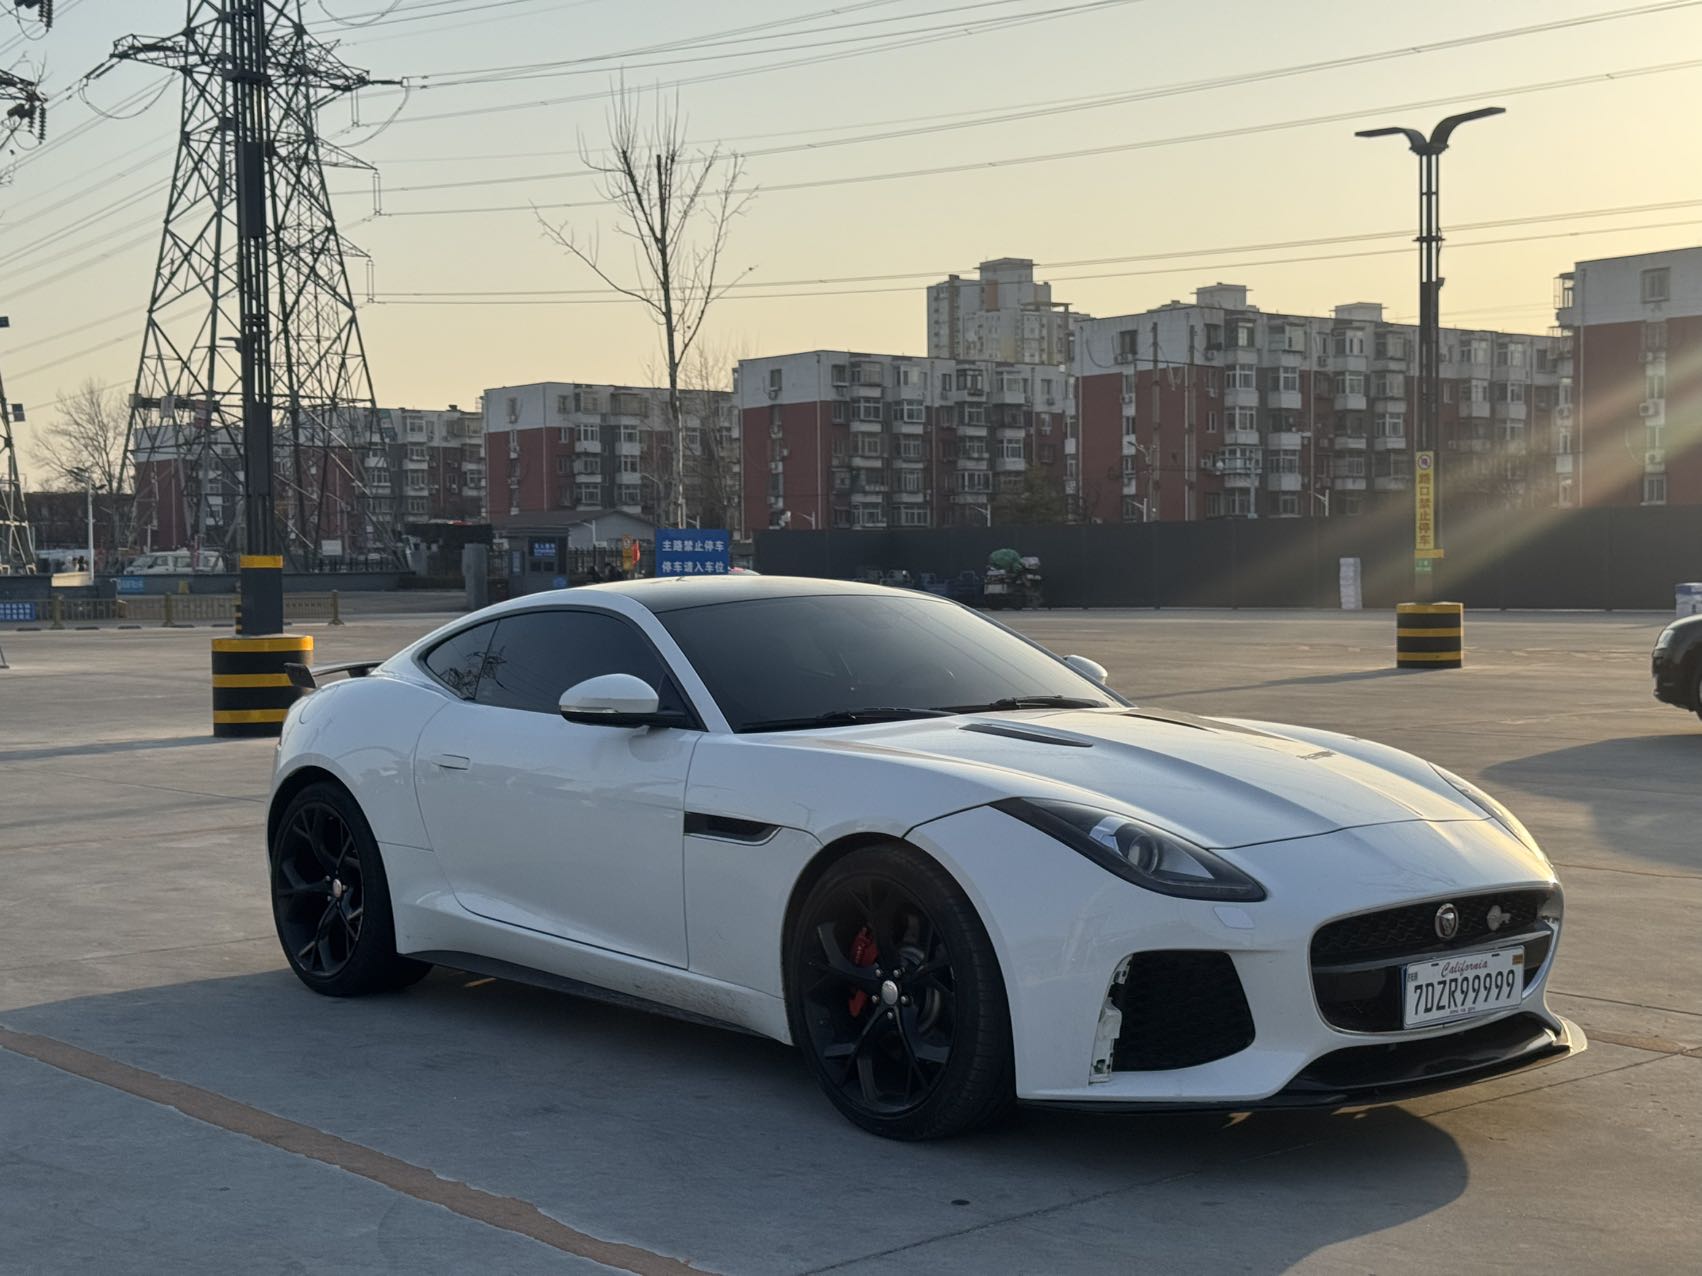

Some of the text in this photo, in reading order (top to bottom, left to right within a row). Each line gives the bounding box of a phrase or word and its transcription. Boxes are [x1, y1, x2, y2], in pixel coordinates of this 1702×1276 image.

[662, 541, 724, 552] 主路禁止停车
[662, 561, 725, 573] 停车请入车位
[1441, 959, 1488, 977] California
[1414, 969, 1515, 1015] 7DZR99999
